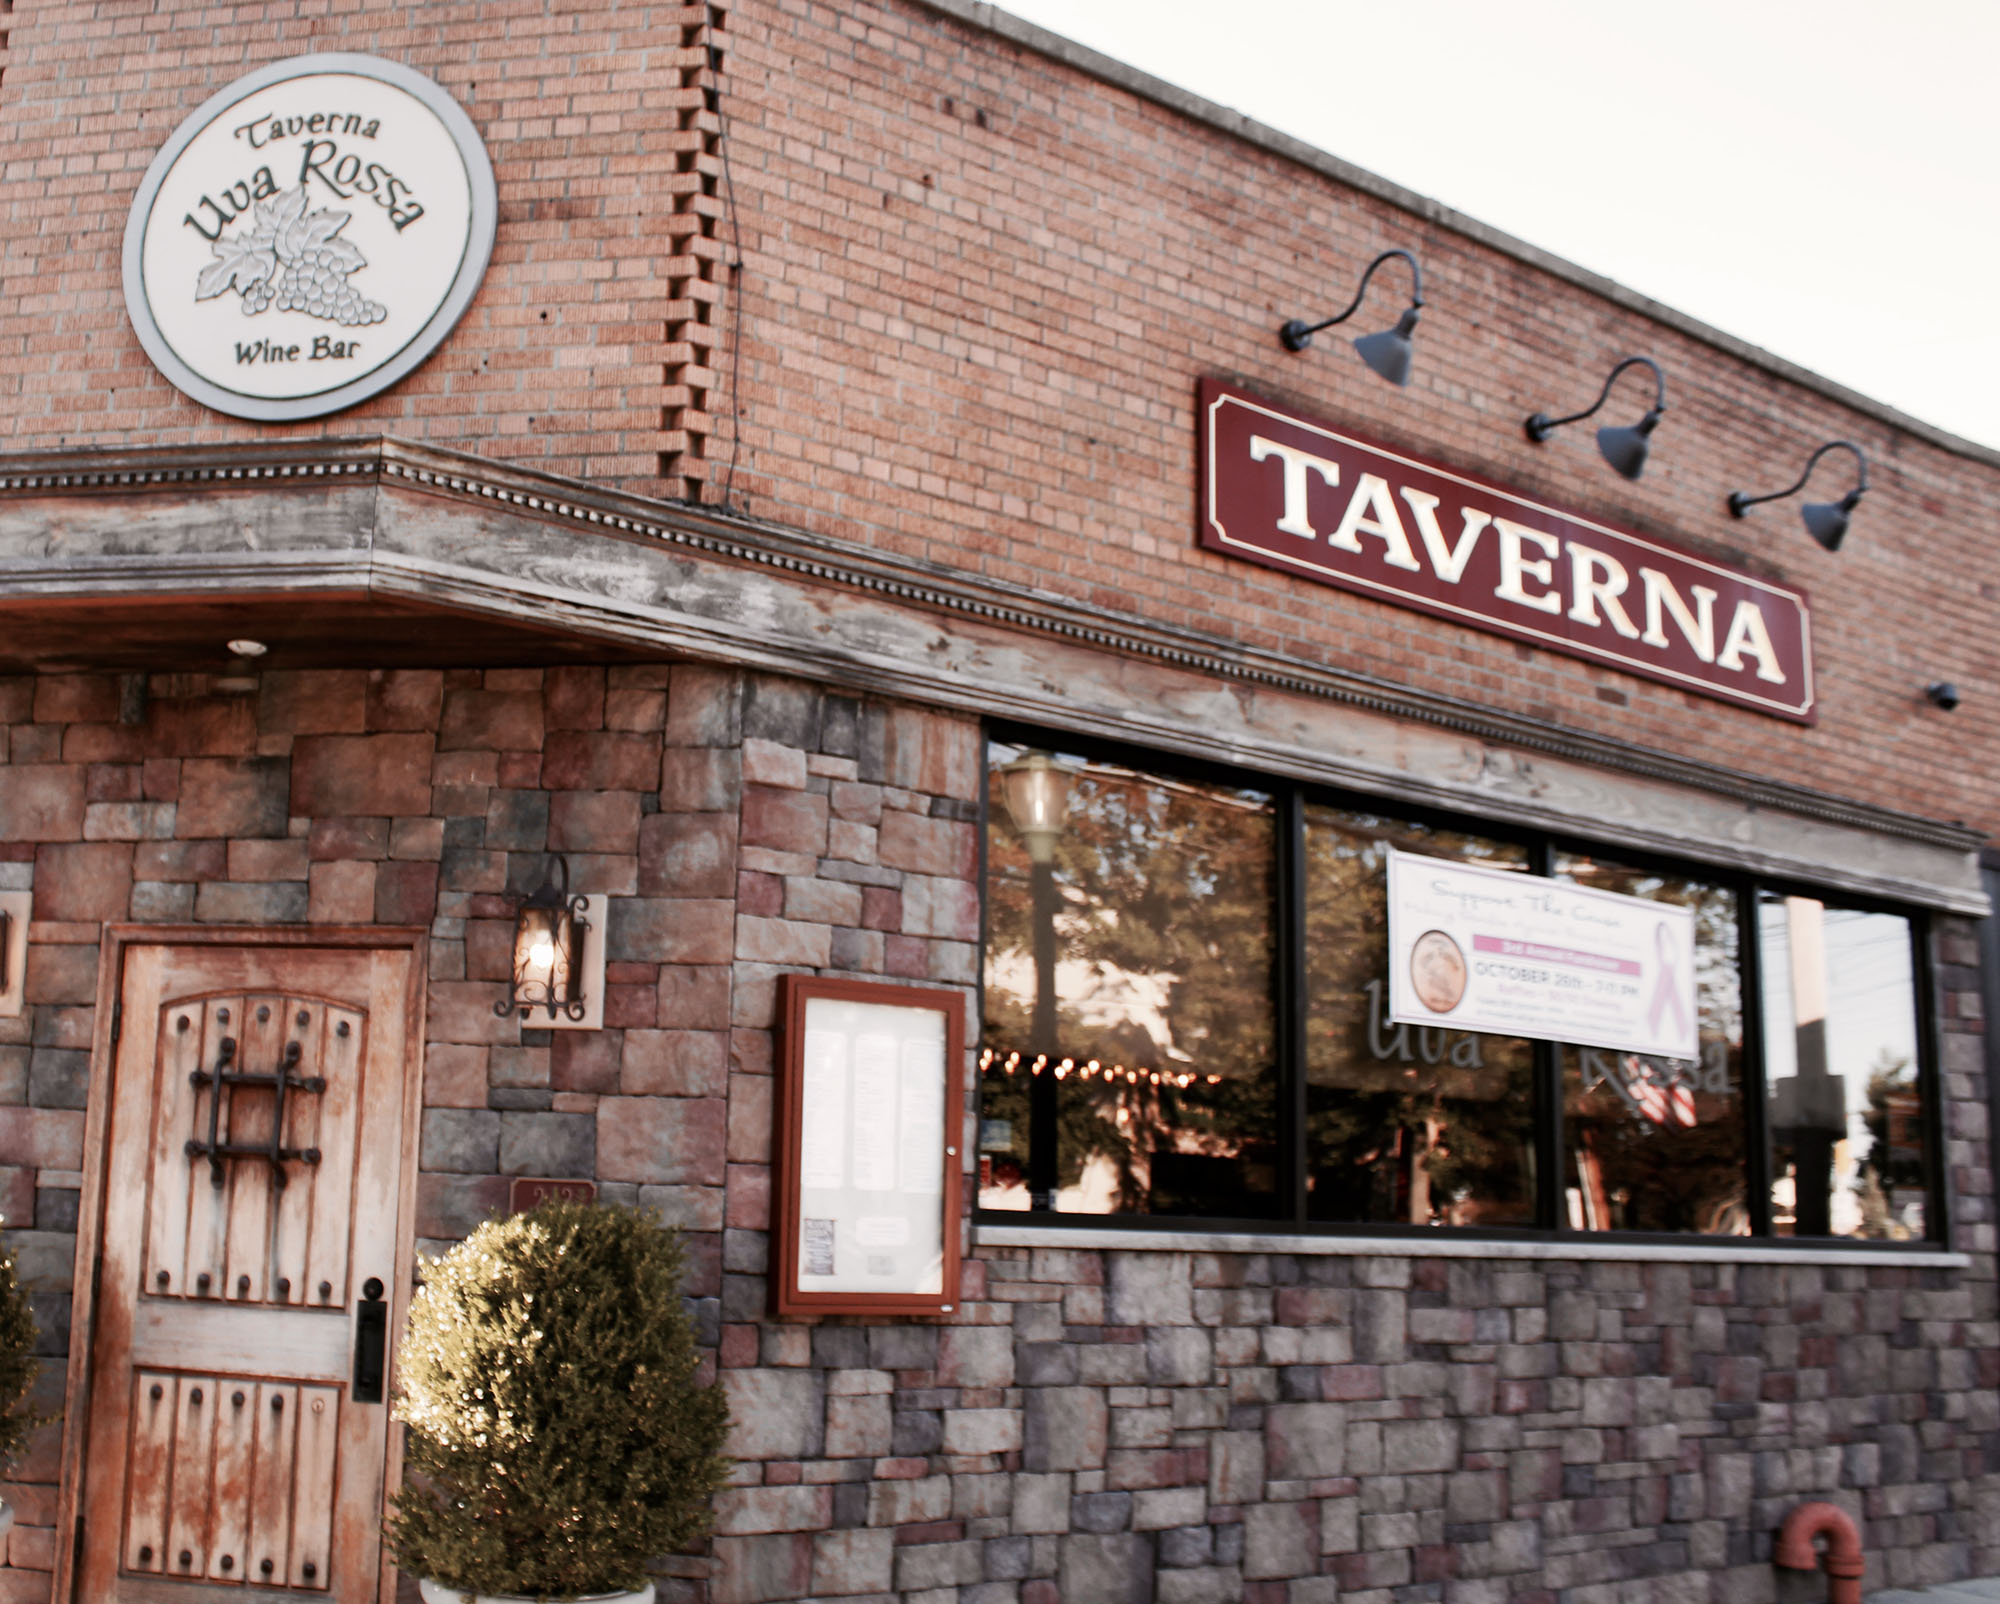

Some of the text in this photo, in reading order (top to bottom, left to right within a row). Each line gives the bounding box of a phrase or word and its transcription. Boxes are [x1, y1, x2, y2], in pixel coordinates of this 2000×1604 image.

[234, 112, 380, 149] Taverna
[183, 139, 425, 241] Uva Rossa
[234, 335, 361, 365] Wine Bar
[1249, 434, 1787, 685] TAVERNA
[1475, 961, 1549, 984] OCTOBER
[1361, 977, 1486, 1069] Uva
